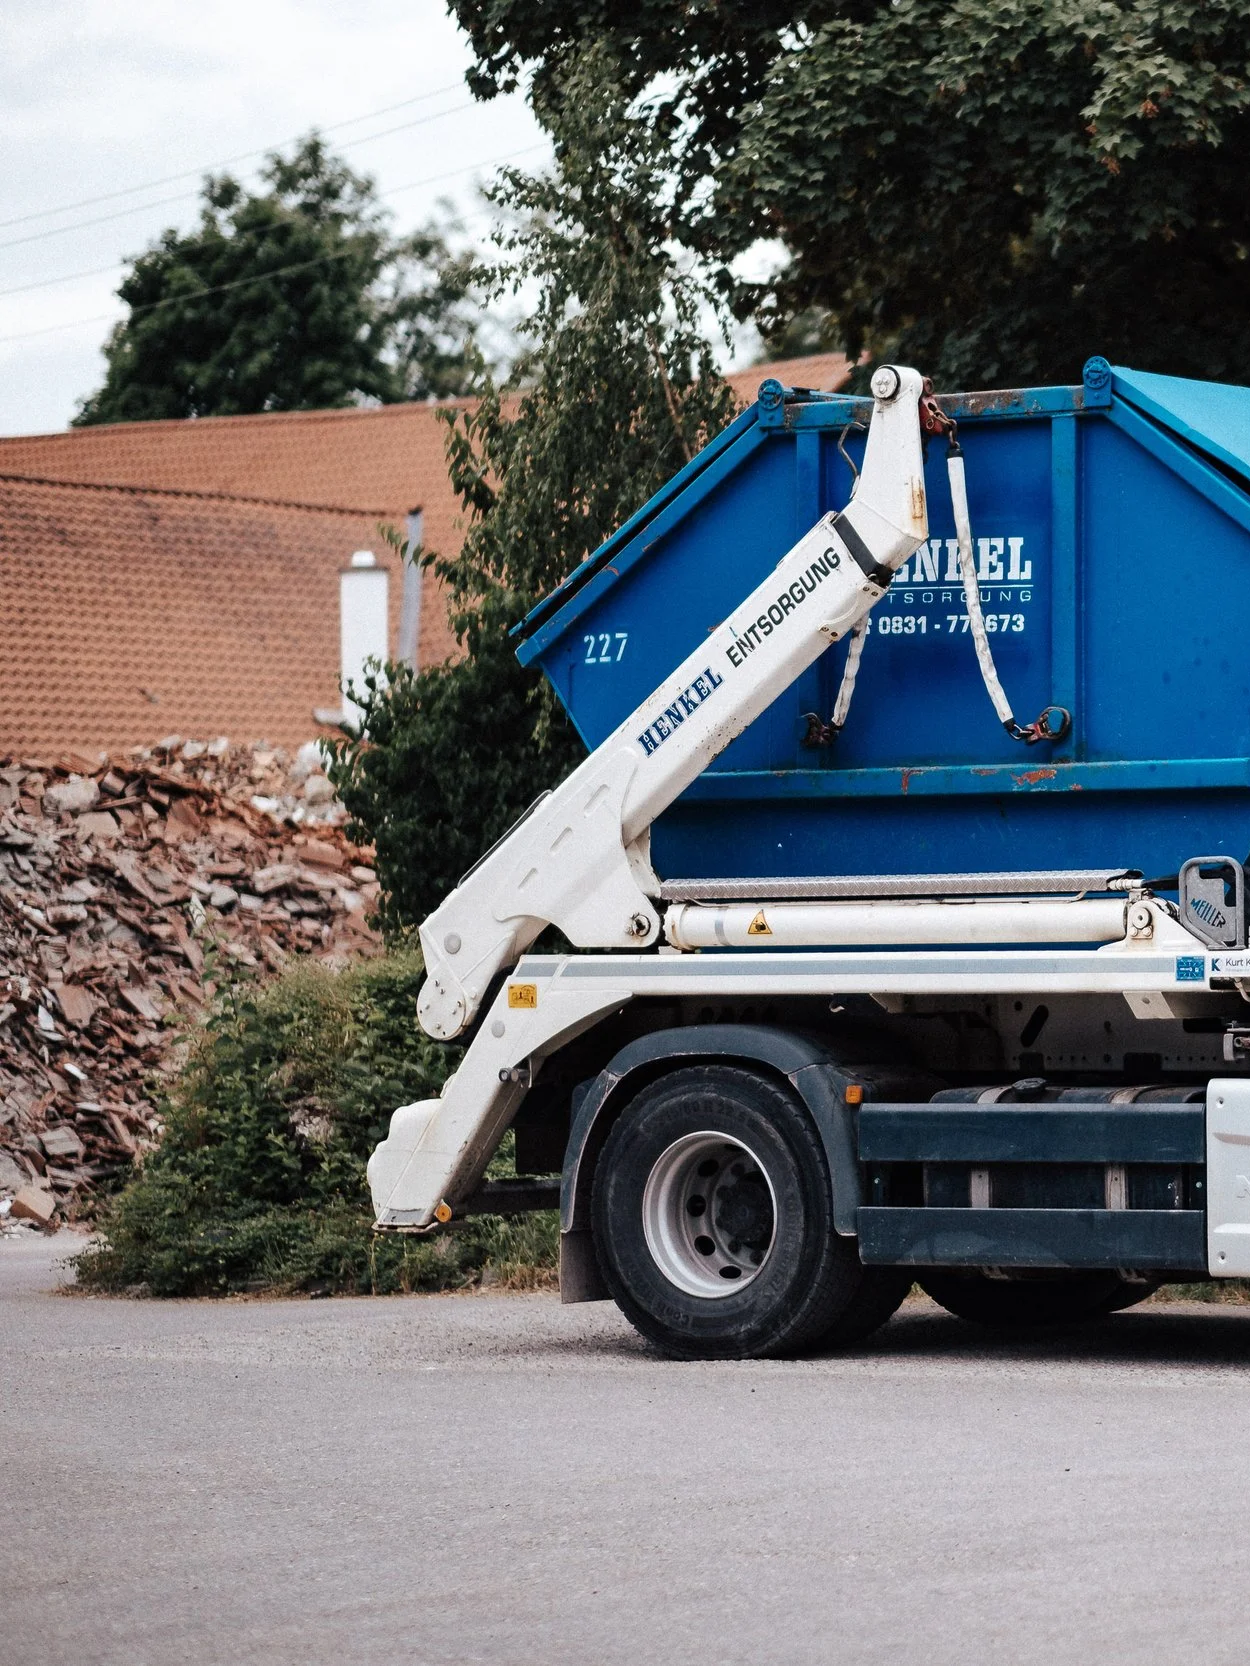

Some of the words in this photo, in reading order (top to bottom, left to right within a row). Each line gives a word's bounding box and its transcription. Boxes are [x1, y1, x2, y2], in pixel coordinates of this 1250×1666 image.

[890, 537, 1032, 582] NKEL
[726, 547, 841, 668] ENTSORGUNG
[878, 615, 927, 635] 0831
[946, 614, 1025, 634] 77673
[584, 633, 628, 664] 227
[636, 665, 725, 759] HENKEL
[1190, 898, 1226, 928] MEILLER
[1225, 959, 1243, 967] Kurt
